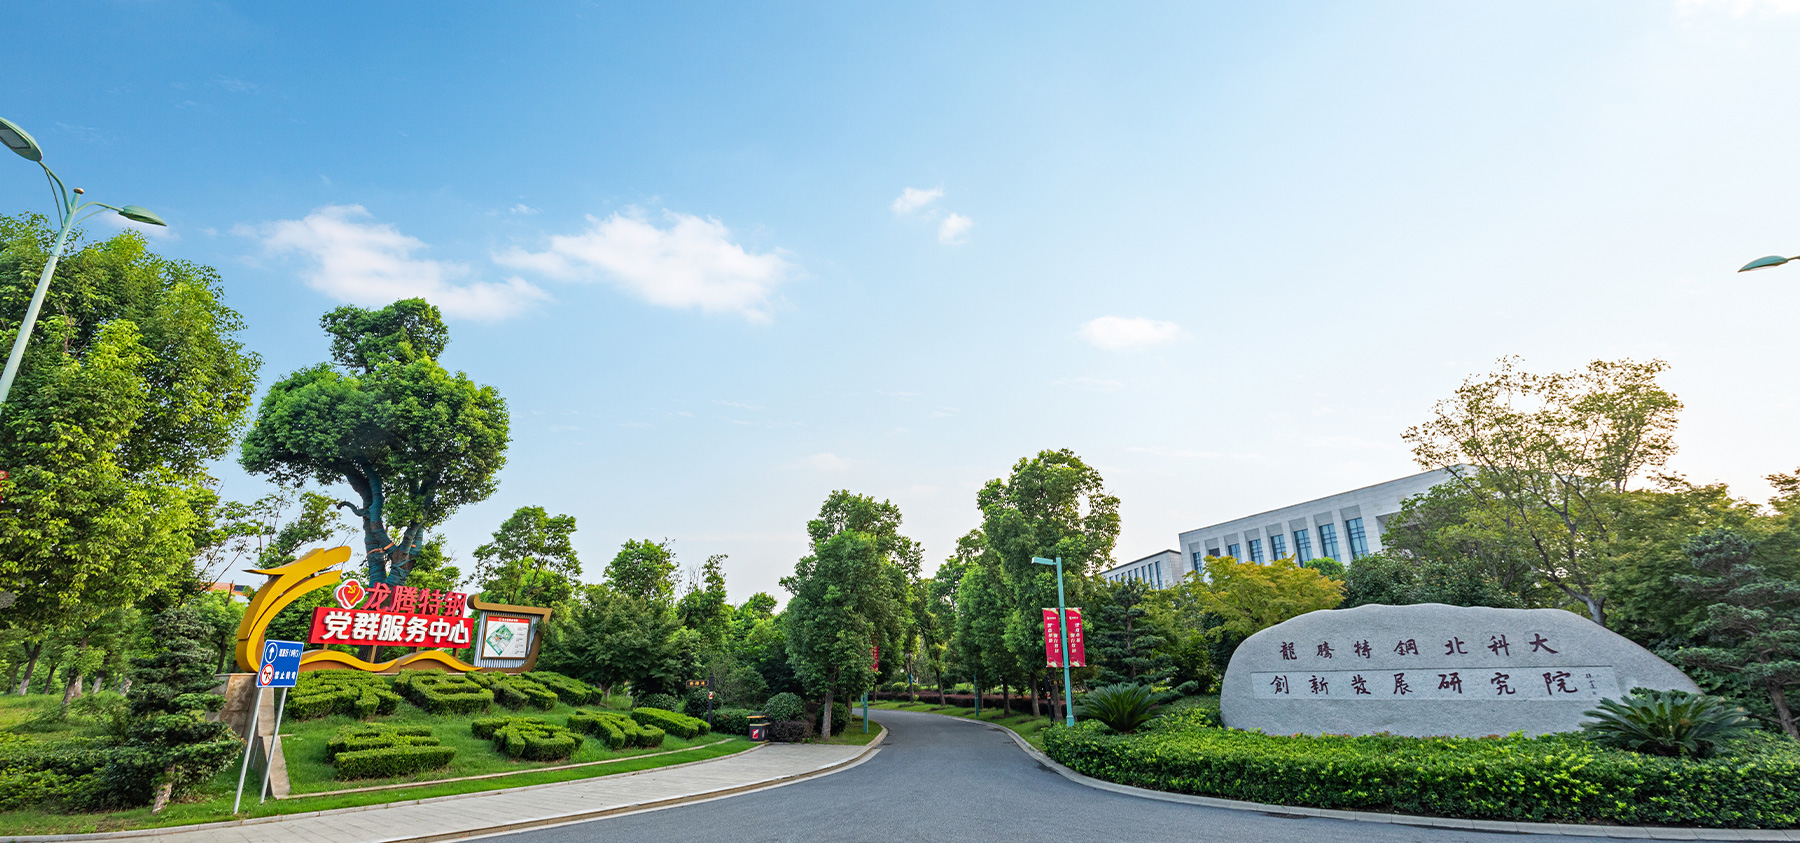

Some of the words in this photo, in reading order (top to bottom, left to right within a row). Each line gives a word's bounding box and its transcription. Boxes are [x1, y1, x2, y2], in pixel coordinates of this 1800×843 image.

[361, 582, 468, 618] 龙腾特钢
[320, 610, 470, 644] 党群服务中心
